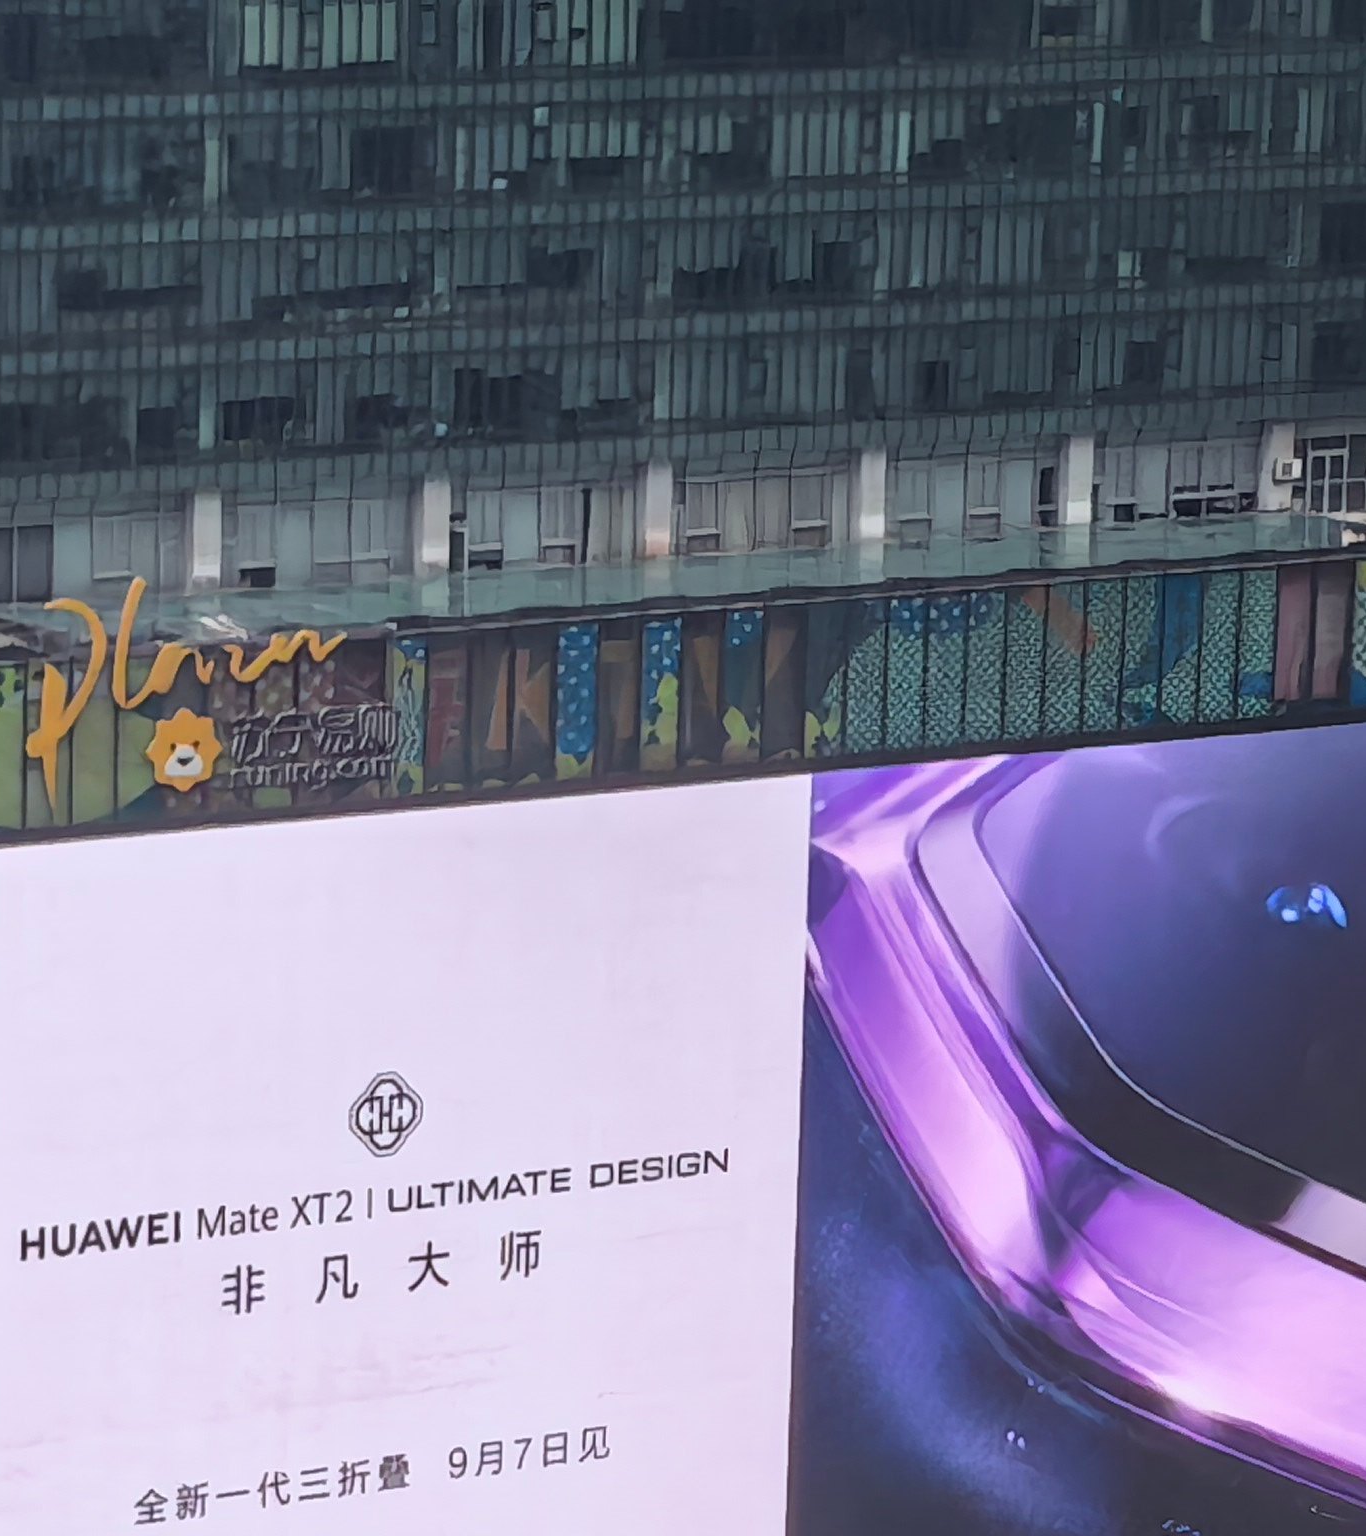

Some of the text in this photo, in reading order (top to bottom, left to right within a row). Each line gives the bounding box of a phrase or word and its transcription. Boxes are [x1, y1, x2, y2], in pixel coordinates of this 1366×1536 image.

[19, 1147, 731, 1262] HUAWEI Mate XT2 ULTIMATE DESIGN
[221, 1229, 543, 1315] 非凡大师
[133, 1424, 612, 1526] 全新一代三折叠 9月7日见
